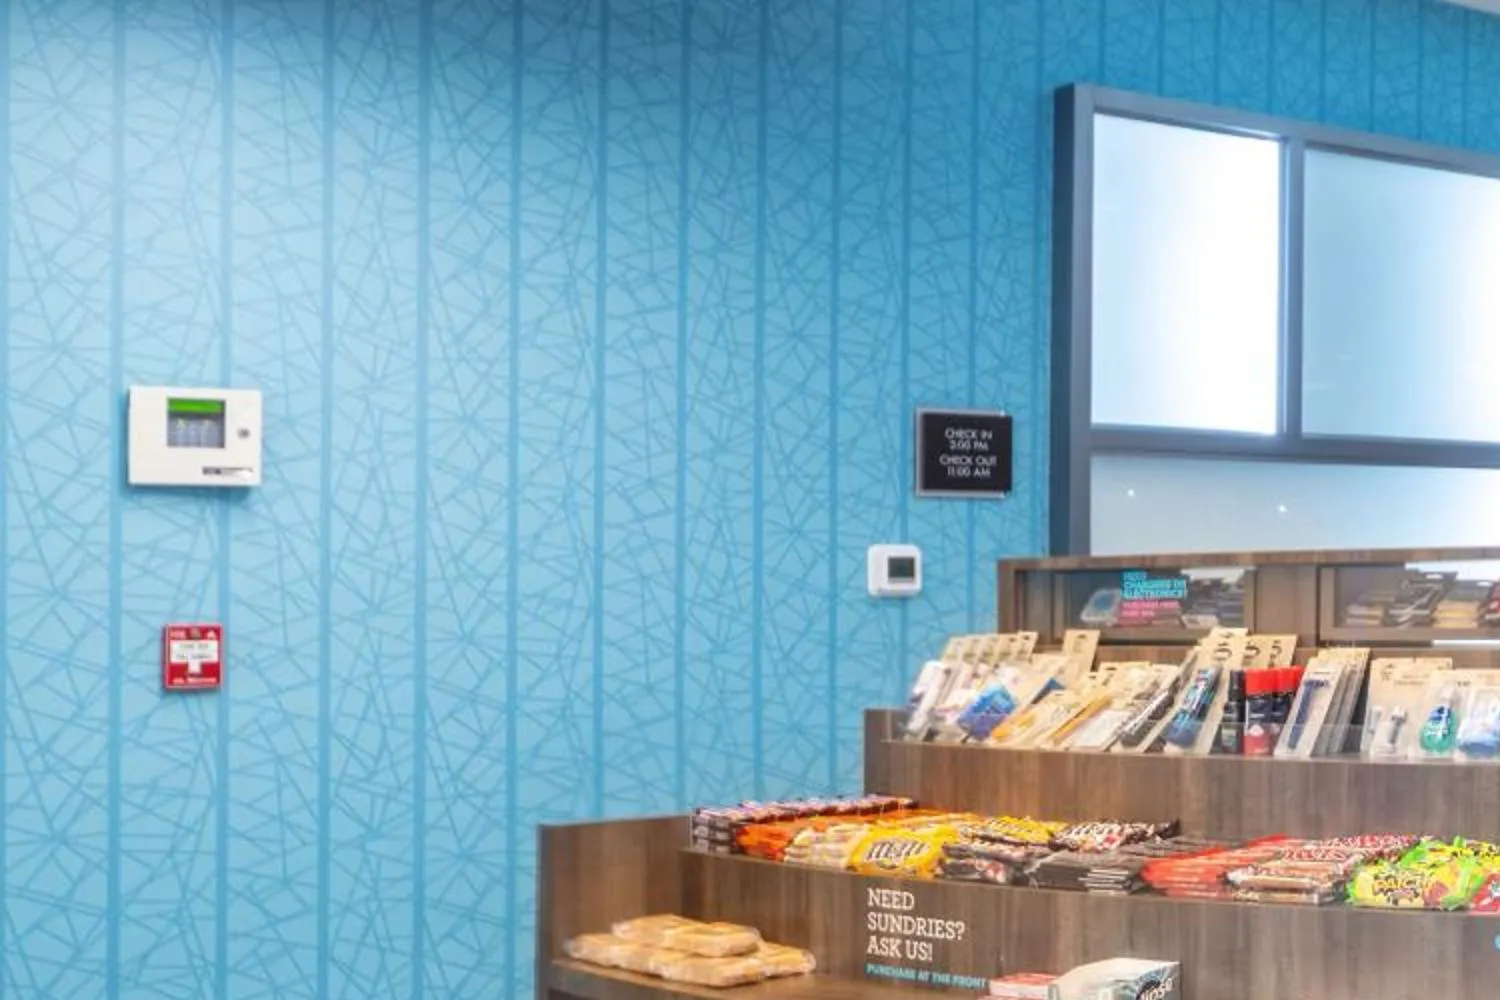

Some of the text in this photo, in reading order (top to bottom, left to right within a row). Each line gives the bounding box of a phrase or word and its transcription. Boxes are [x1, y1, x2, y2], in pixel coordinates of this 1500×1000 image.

[944, 427, 993, 440] CHECK IN
[973, 441, 989, 450] PM
[939, 454, 997, 467] CHECK OUT
[973, 467, 991, 478] AM
[867, 887, 915, 910] NEED
[867, 911, 965, 940] SUNDRIES?
[867, 935, 933, 961] ASK US!
